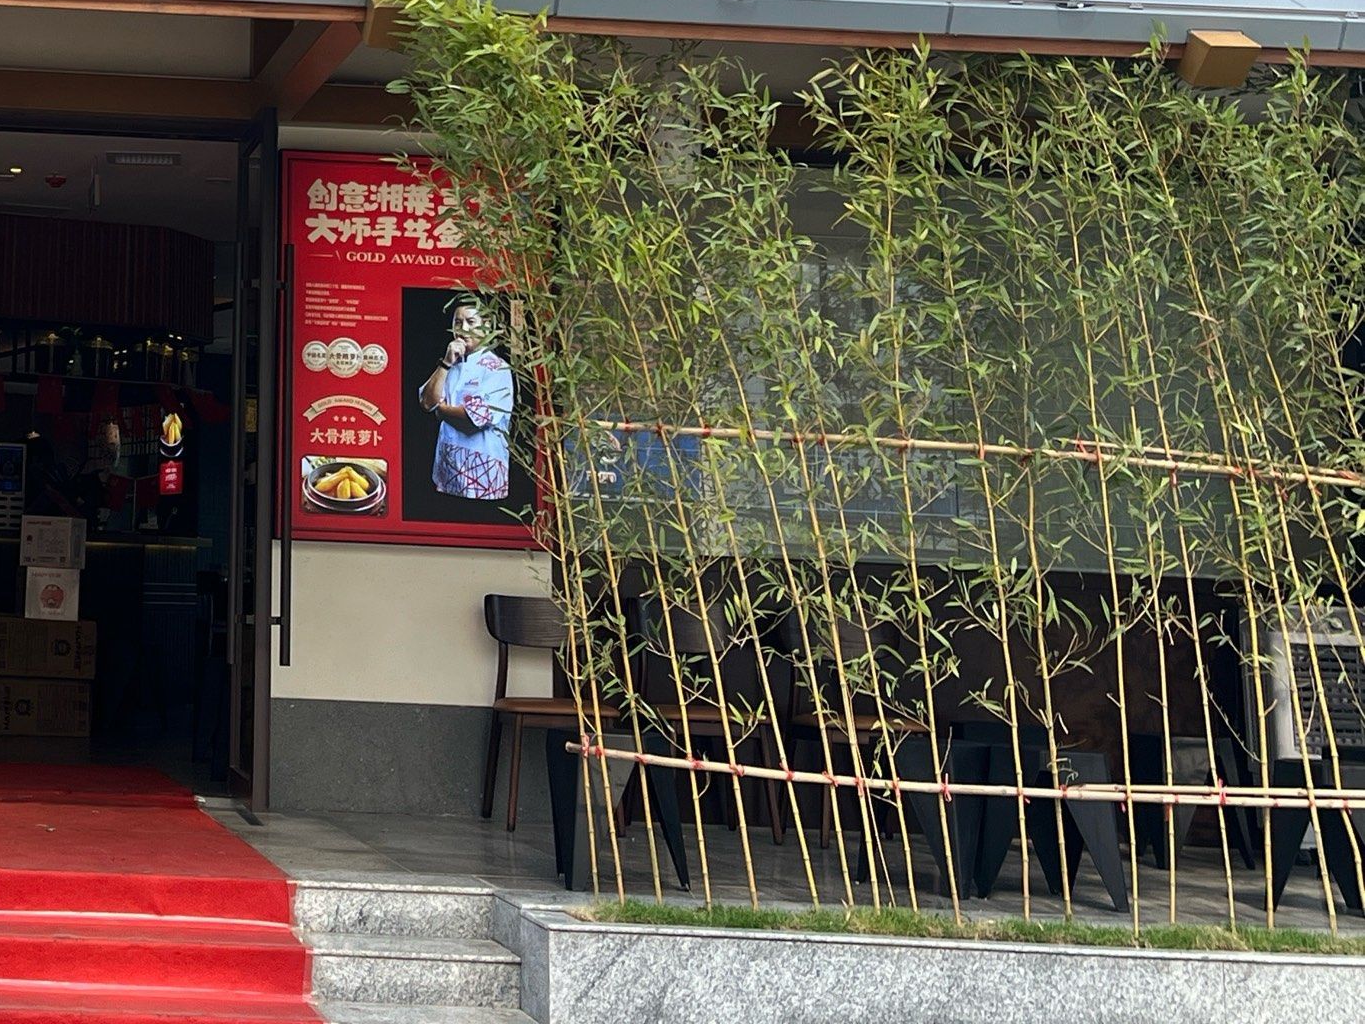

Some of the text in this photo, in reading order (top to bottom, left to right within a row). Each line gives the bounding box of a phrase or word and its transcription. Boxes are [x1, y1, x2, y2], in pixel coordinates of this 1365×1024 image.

[346, 251, 386, 264] GOLD
[390, 253, 445, 266] AWARD
[310, 427, 383, 447] 大骨煨萝卜
